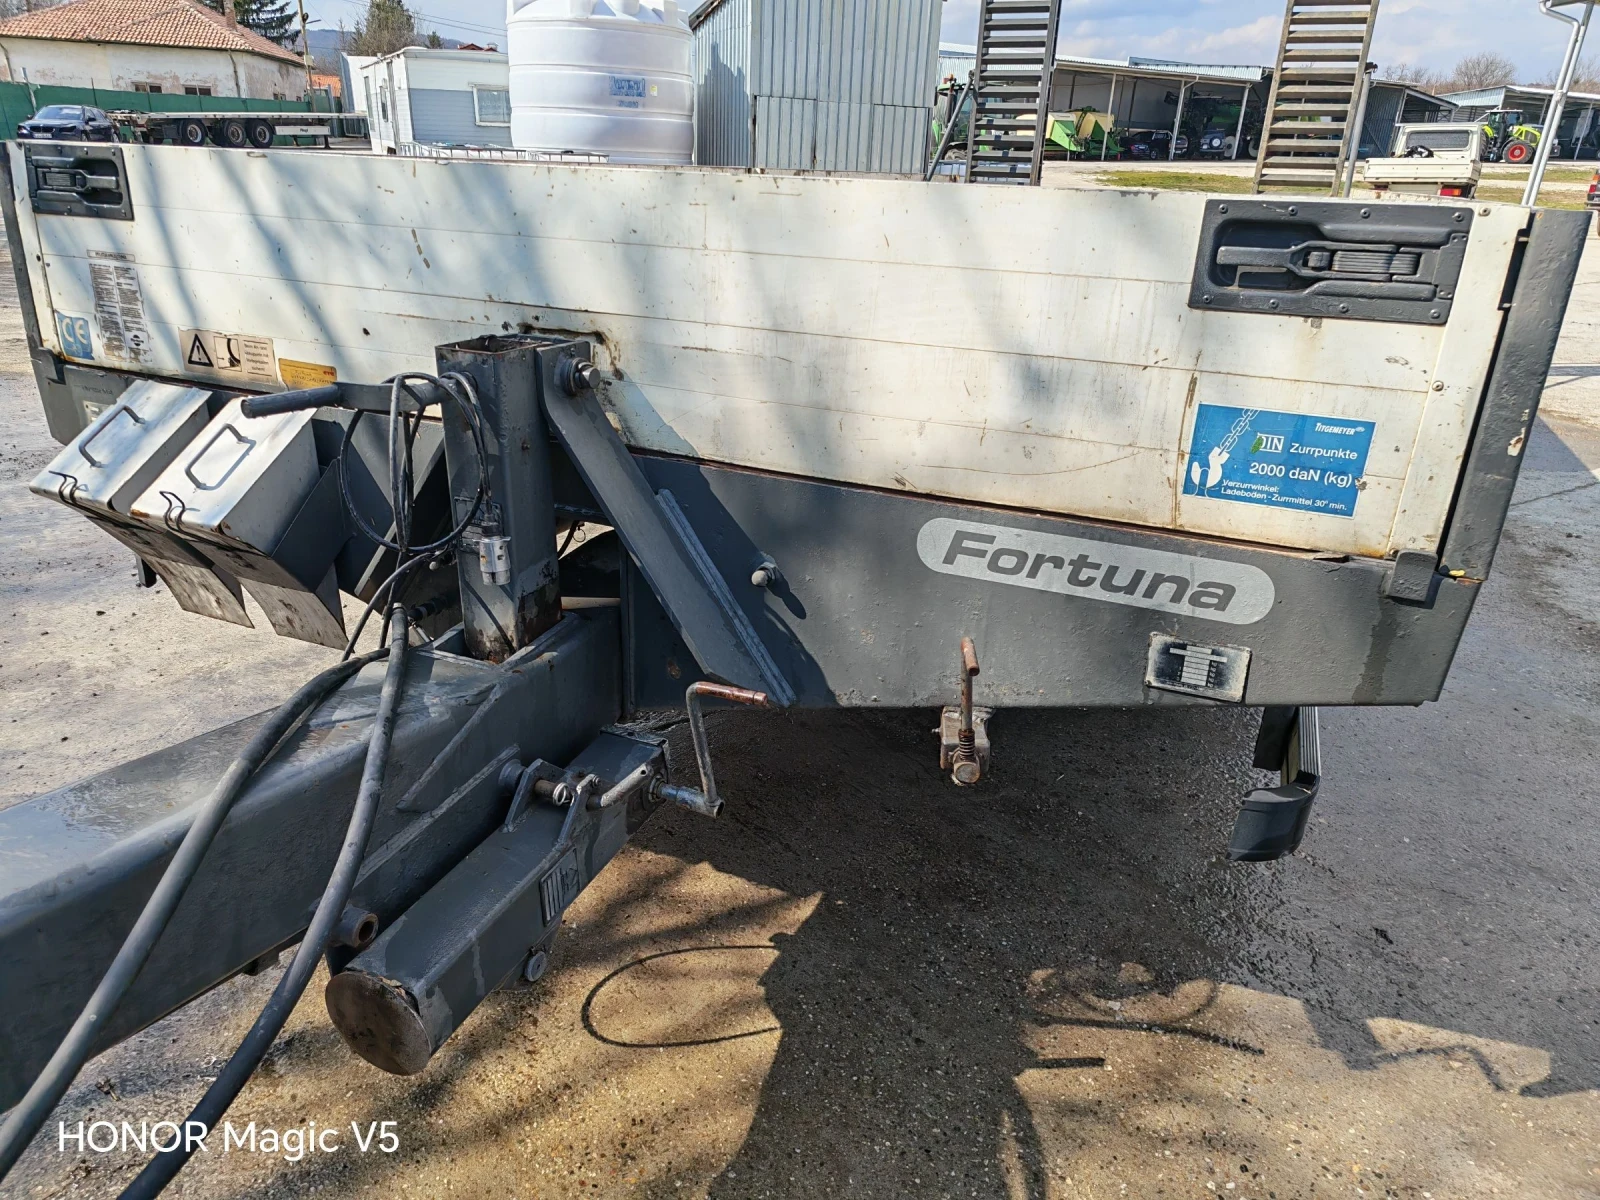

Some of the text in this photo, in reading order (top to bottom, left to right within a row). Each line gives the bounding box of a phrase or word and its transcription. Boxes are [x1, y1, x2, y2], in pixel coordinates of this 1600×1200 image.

[62, 318, 87, 344] CE
[1257, 433, 1358, 460] DIN Zurrpunkte
[1222, 479, 1280, 494] Verzurrwinkel:
[1249, 462, 1352, 488] 2000 daN (kg)
[1221, 487, 1267, 500] Ladeboden
[1271, 494, 1313, 506] Zurrmittel
[1329, 501, 1348, 511] min.
[942, 530, 1237, 612] Fortuna
